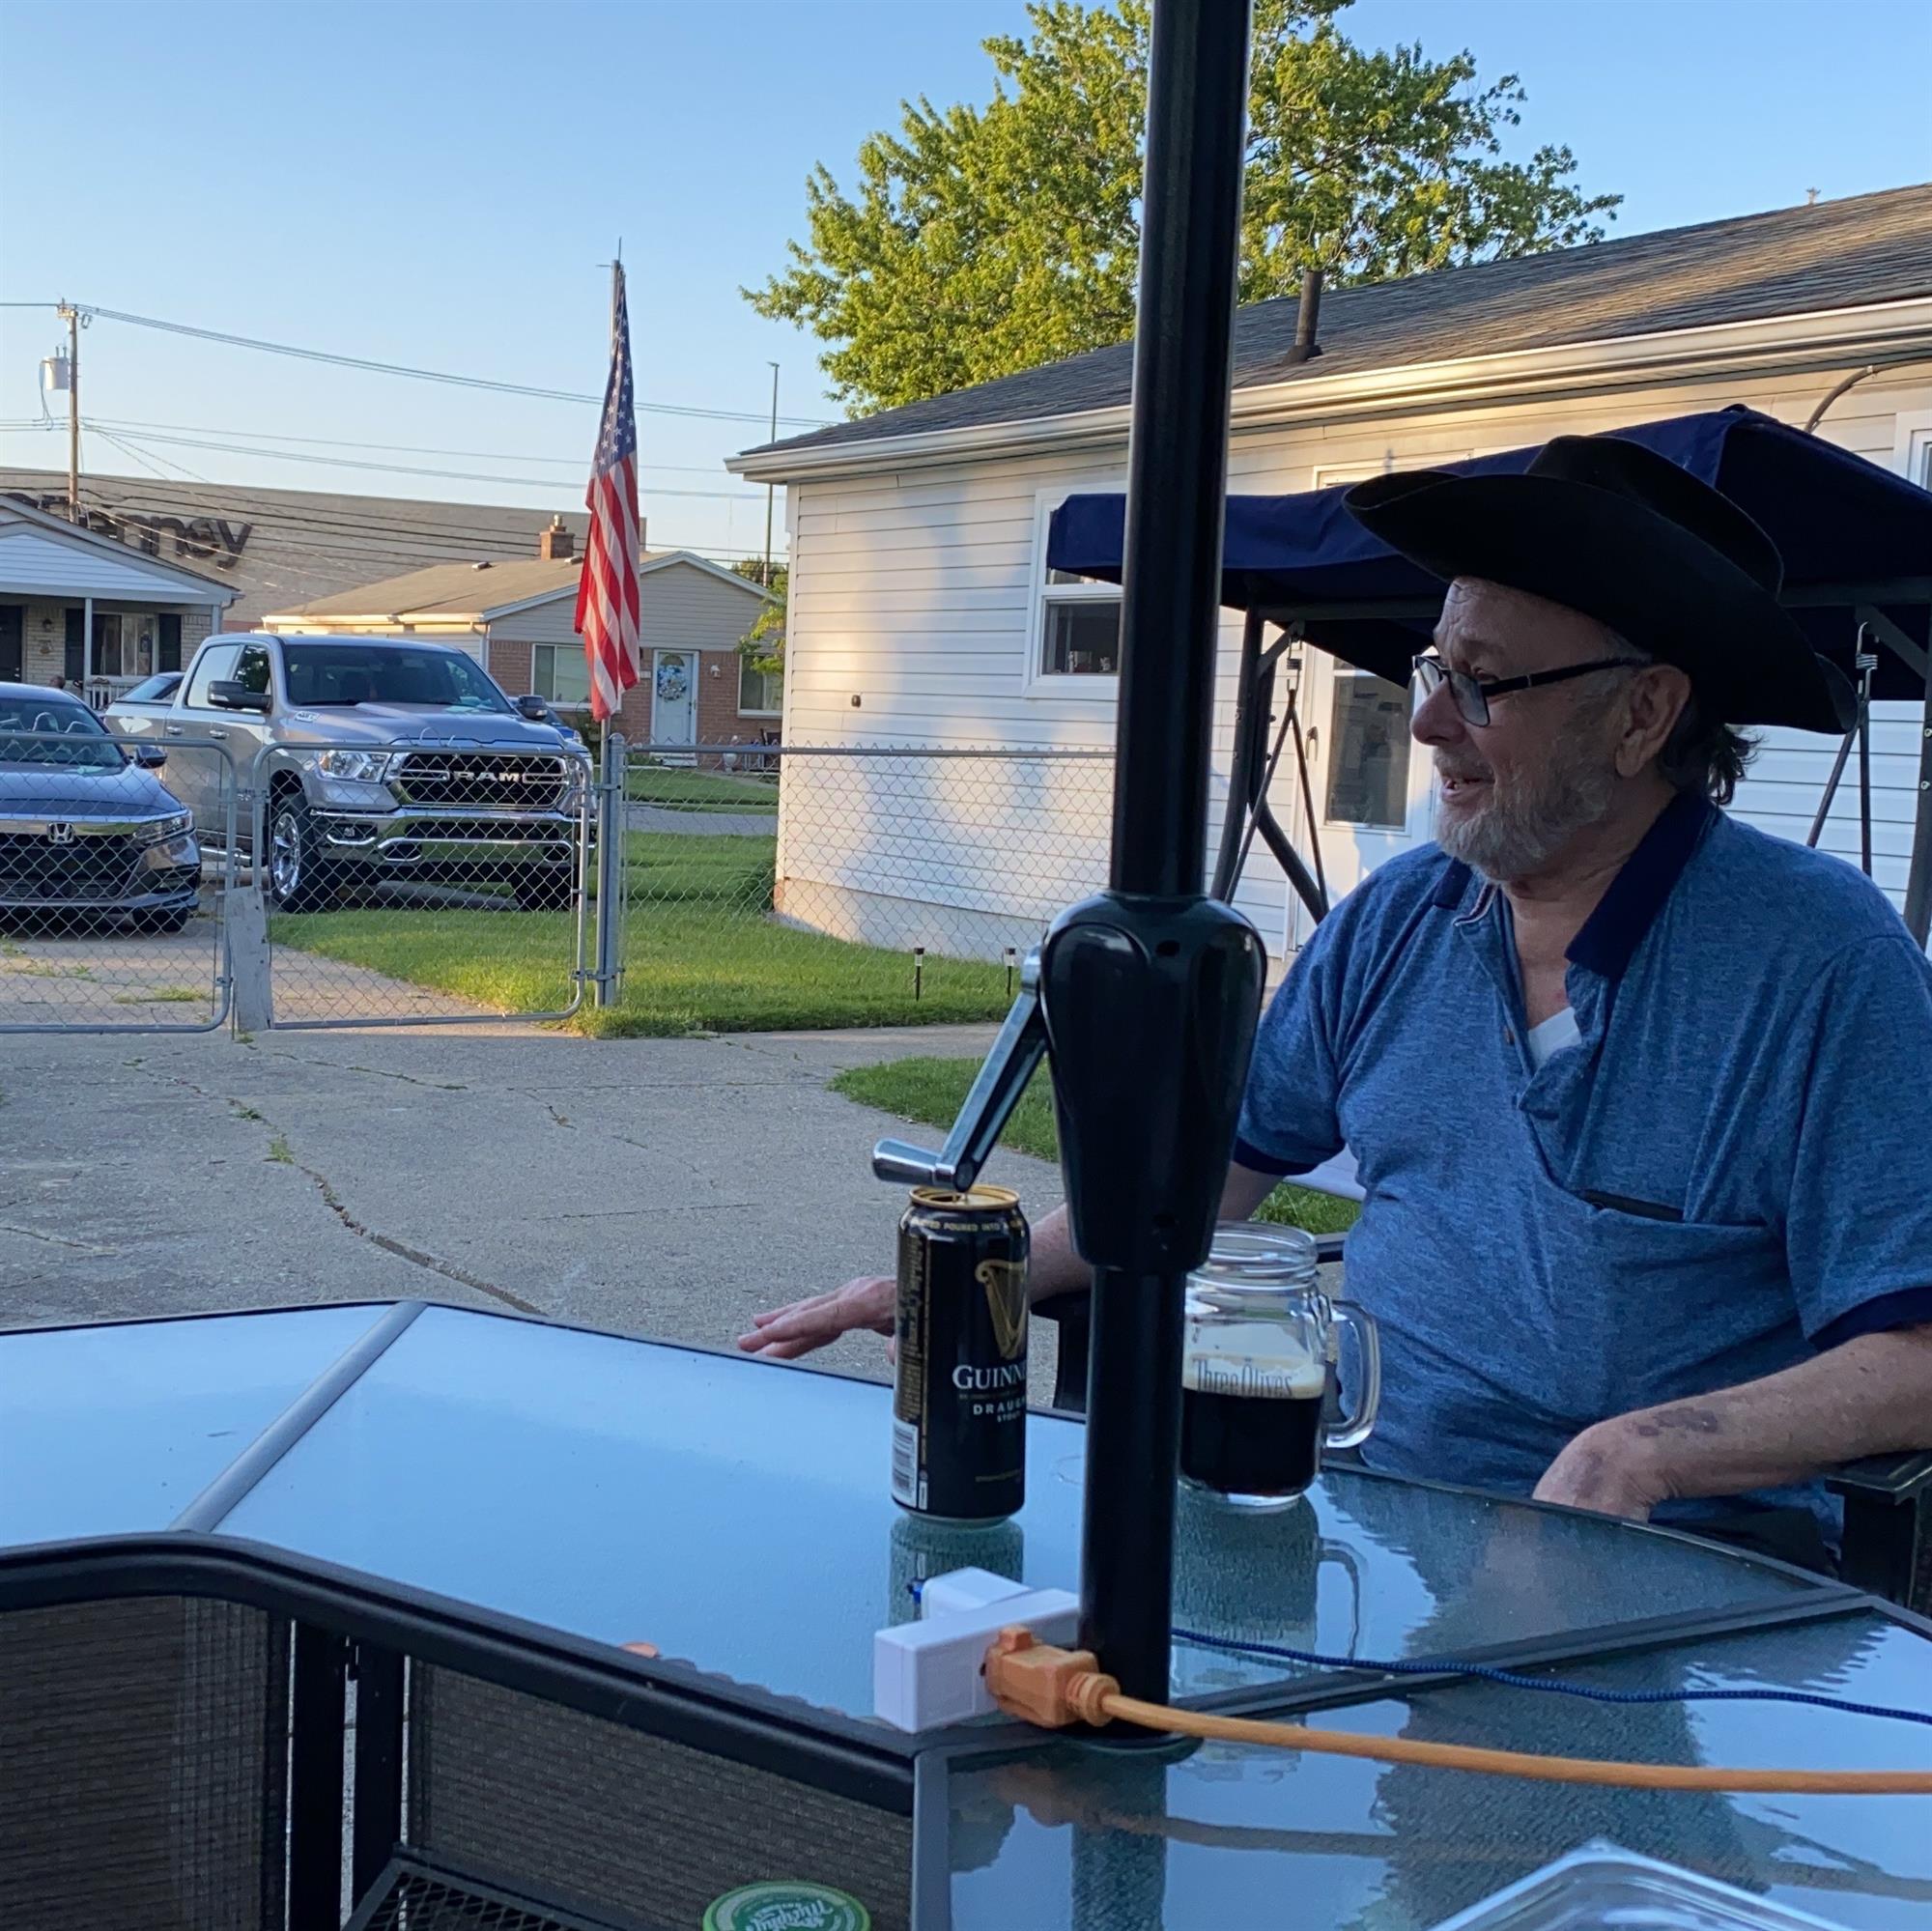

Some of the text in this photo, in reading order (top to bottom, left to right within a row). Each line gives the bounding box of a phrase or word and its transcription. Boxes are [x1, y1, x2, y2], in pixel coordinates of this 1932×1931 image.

[453, 771, 520, 782] RAM
[952, 1364, 1026, 1389] GUINN
[1192, 1357, 1293, 1398] Three Olives
